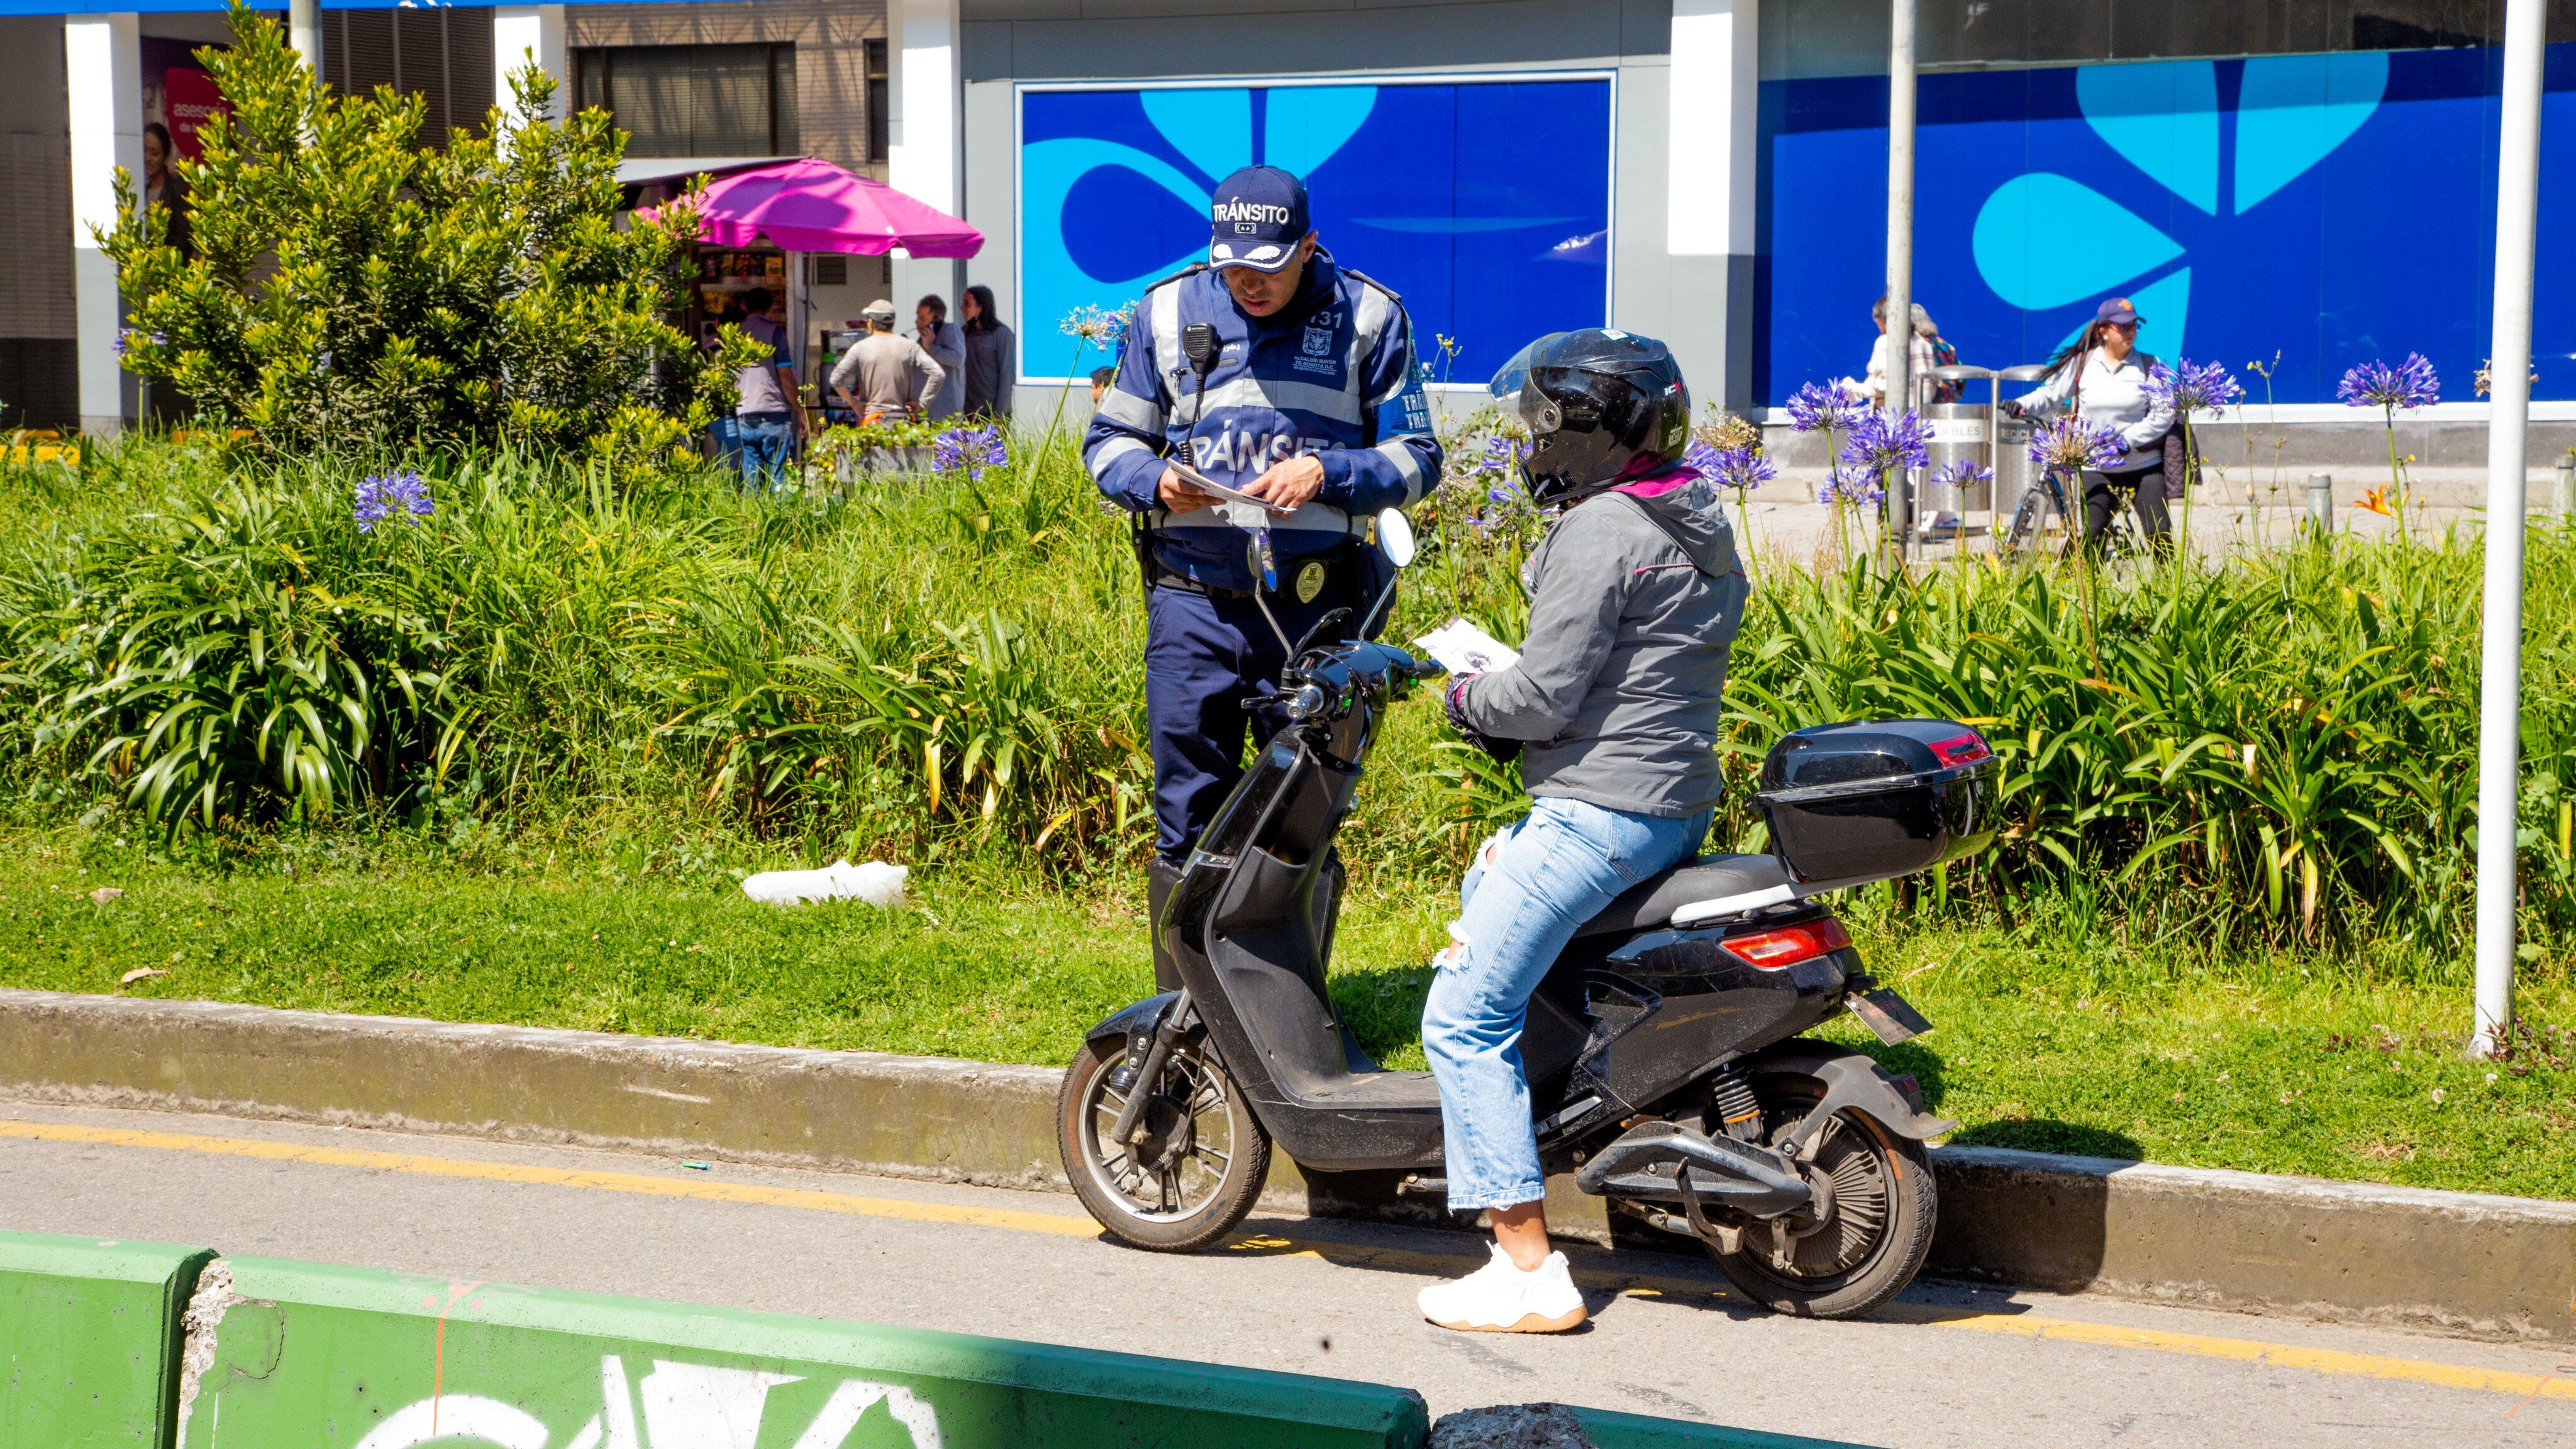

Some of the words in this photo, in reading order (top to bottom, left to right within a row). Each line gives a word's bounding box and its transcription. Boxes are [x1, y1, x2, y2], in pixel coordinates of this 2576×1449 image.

[1213, 196, 1289, 225] TRÁNSITO
[1175, 419, 1346, 474] RÁNSIT
[2001, 428, 2033, 440] RECICL
